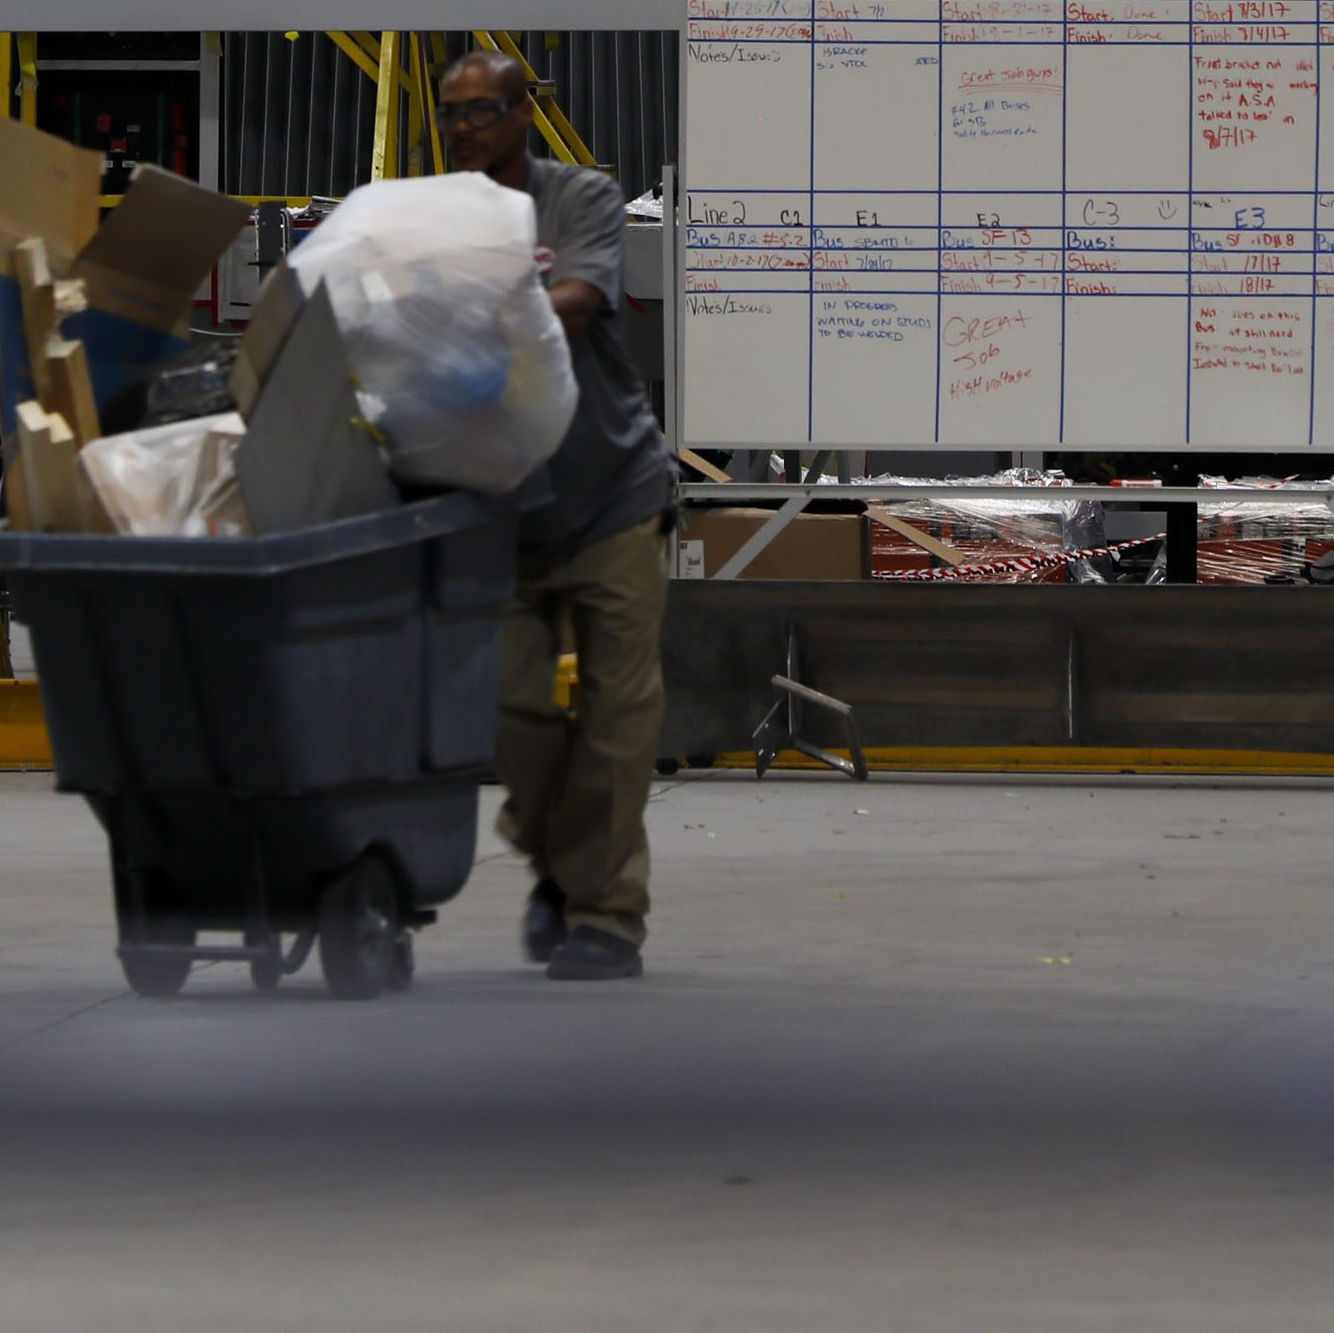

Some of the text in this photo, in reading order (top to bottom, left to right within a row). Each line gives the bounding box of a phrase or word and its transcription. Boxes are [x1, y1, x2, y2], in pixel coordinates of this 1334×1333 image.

[816, 1, 859, 19] Start
[1193, 2, 1234, 23] Start
[1193, 26, 1232, 43] Finish
[687, 195, 804, 226] Line 2 C1
[856, 210, 882, 227] E1
[1083, 199, 1120, 226] C-3
[1234, 207, 1266, 229] E3
[977, 213, 1002, 227] E2
[687, 229, 721, 247] Bus
[814, 229, 844, 248] Bus
[1012, 228, 1033, 246] 13
[1067, 230, 1115, 248] Bus:
[1192, 233, 1224, 251] Bus
[814, 251, 849, 269] Start
[942, 252, 980, 270] Start
[940, 275, 981, 293] Finish
